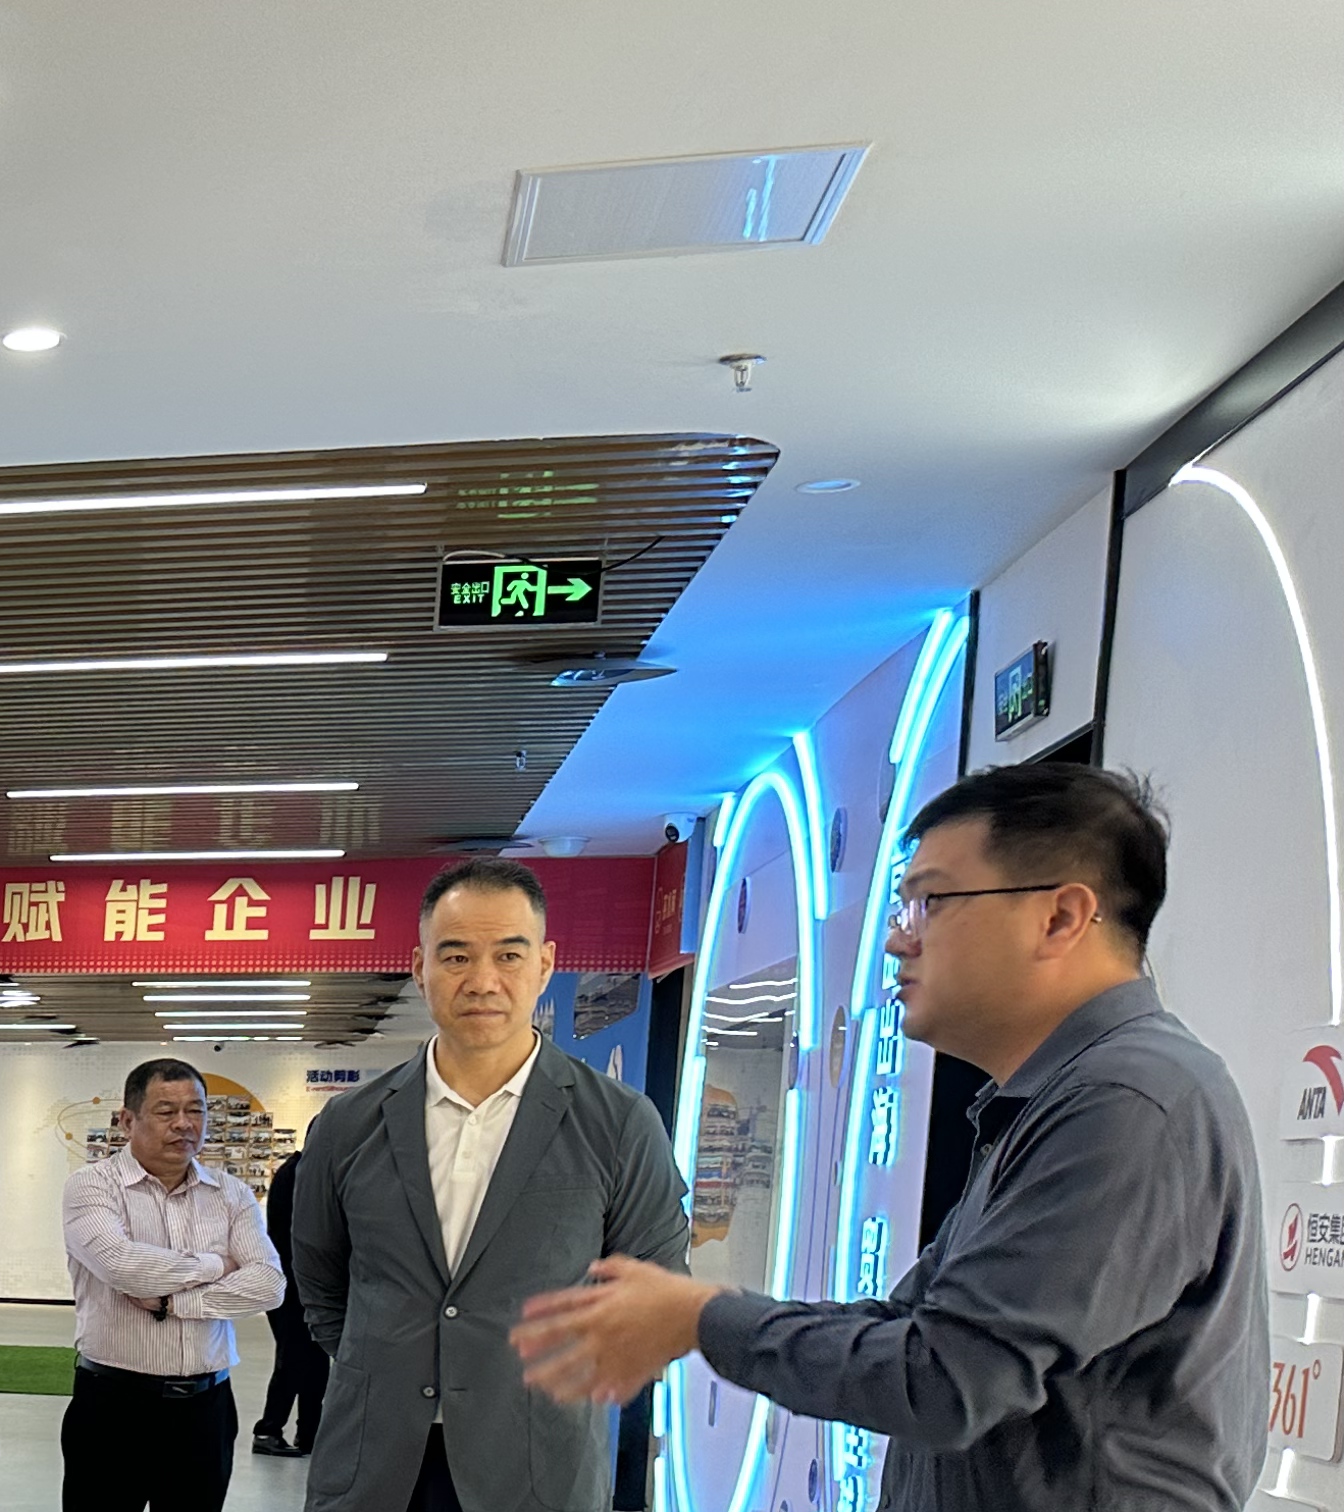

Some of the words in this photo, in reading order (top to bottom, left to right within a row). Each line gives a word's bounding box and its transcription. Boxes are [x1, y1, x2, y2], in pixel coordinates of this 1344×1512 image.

[451, 581, 490, 595] 安全出口
[454, 594, 485, 604] EXIT
[1, 876, 377, 942] 赋能企业
[1297, 1086, 1327, 1120] ANTA
[1307, 1213, 1344, 1245] 恒安集
